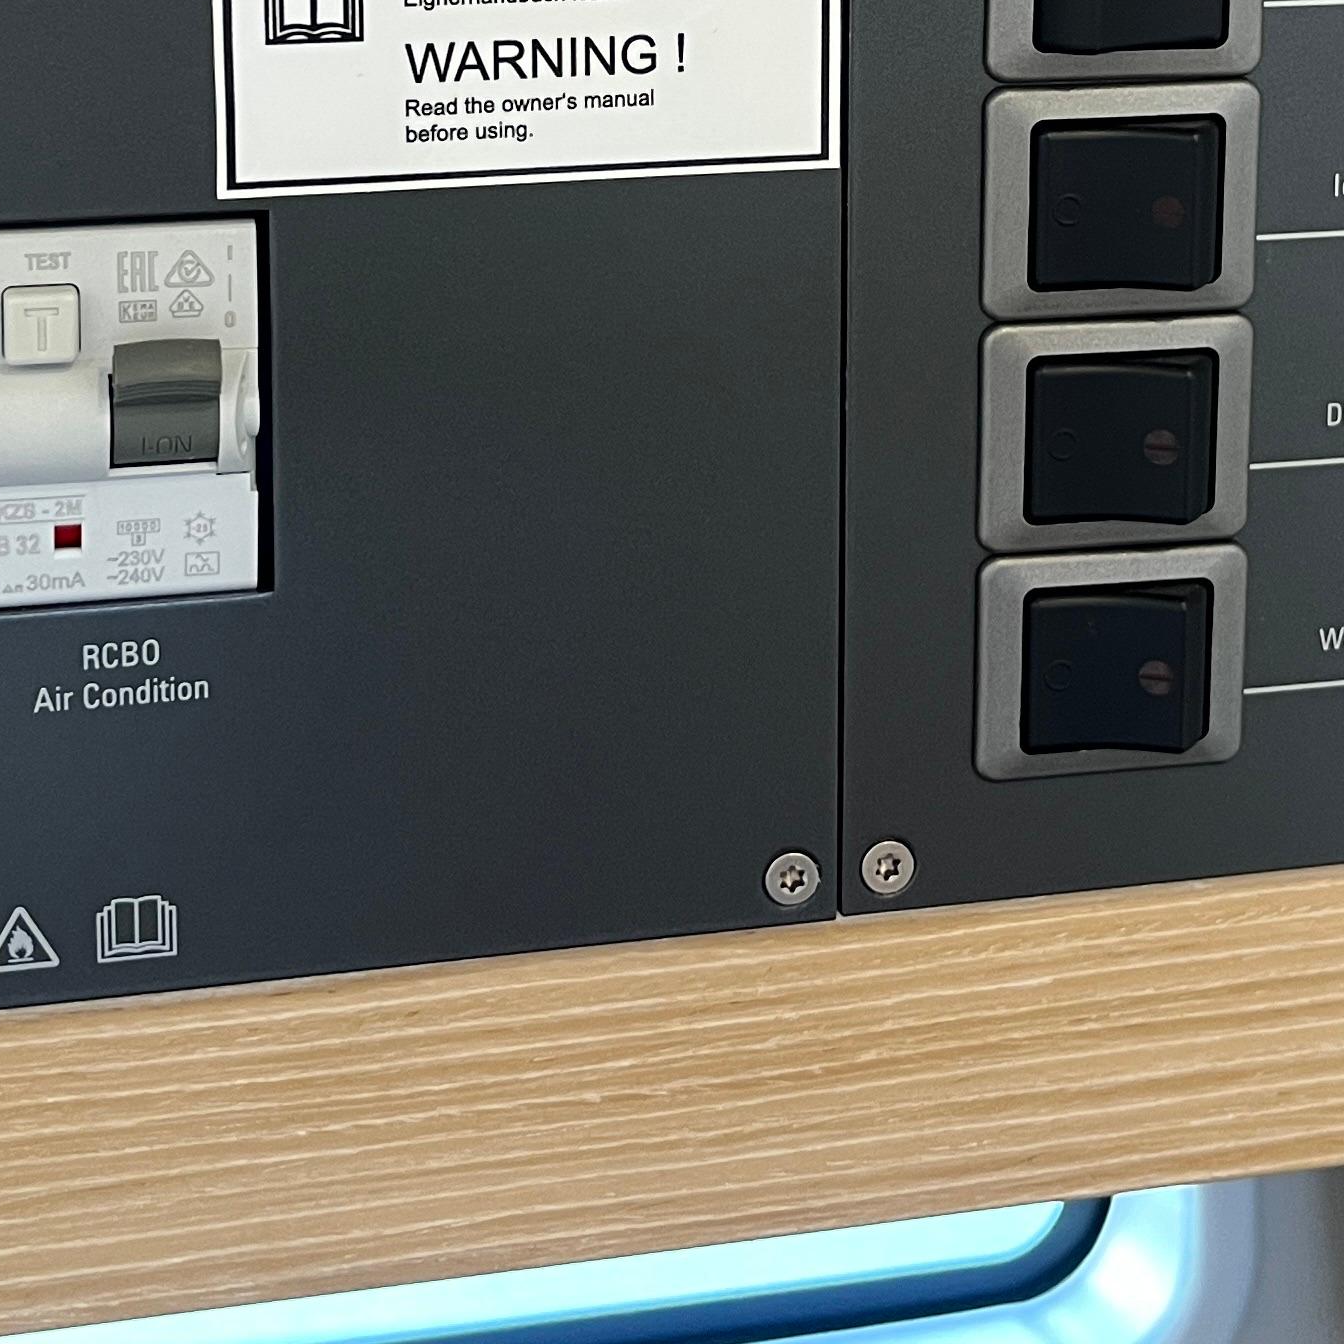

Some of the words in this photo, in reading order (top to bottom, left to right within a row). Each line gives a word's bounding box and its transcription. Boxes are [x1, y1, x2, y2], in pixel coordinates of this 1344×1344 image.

[404, 34, 657, 84] WARNING
[677, 32, 685, 73] !
[405, 97, 458, 118] Read
[464, 96, 495, 115] the
[501, 92, 578, 113] owner's
[584, 88, 655, 109] manual
[405, 123, 469, 143] before
[475, 120, 534, 143] using.
[23, 251, 72, 272] TEST
[56, 498, 82, 516] 2M
[15, 535, 41, 555] 32
[82, 638, 160, 671] RCBO
[33, 685, 74, 714] Air
[83, 676, 209, 709] Condition
